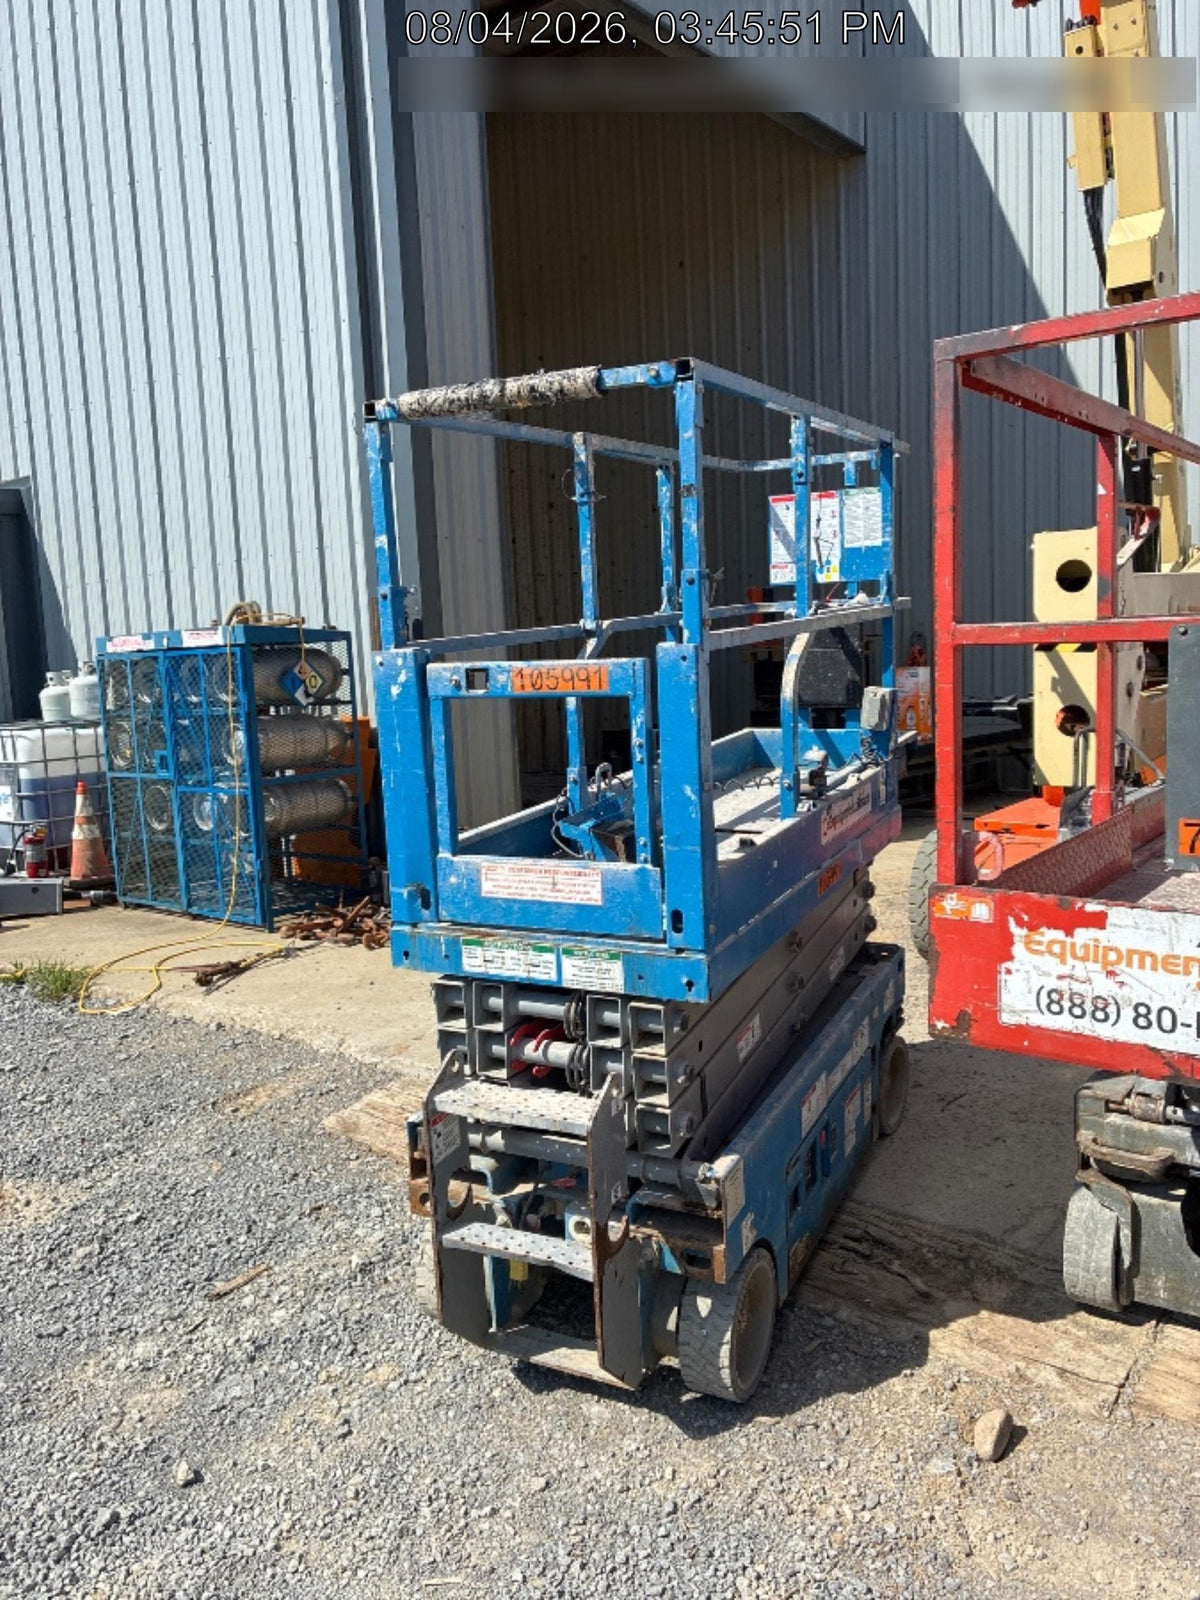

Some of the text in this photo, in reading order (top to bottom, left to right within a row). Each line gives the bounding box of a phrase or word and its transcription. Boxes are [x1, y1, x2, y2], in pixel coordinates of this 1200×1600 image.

[514, 665, 603, 691] 105991
[1036, 985, 1200, 1039] (888) 80-
